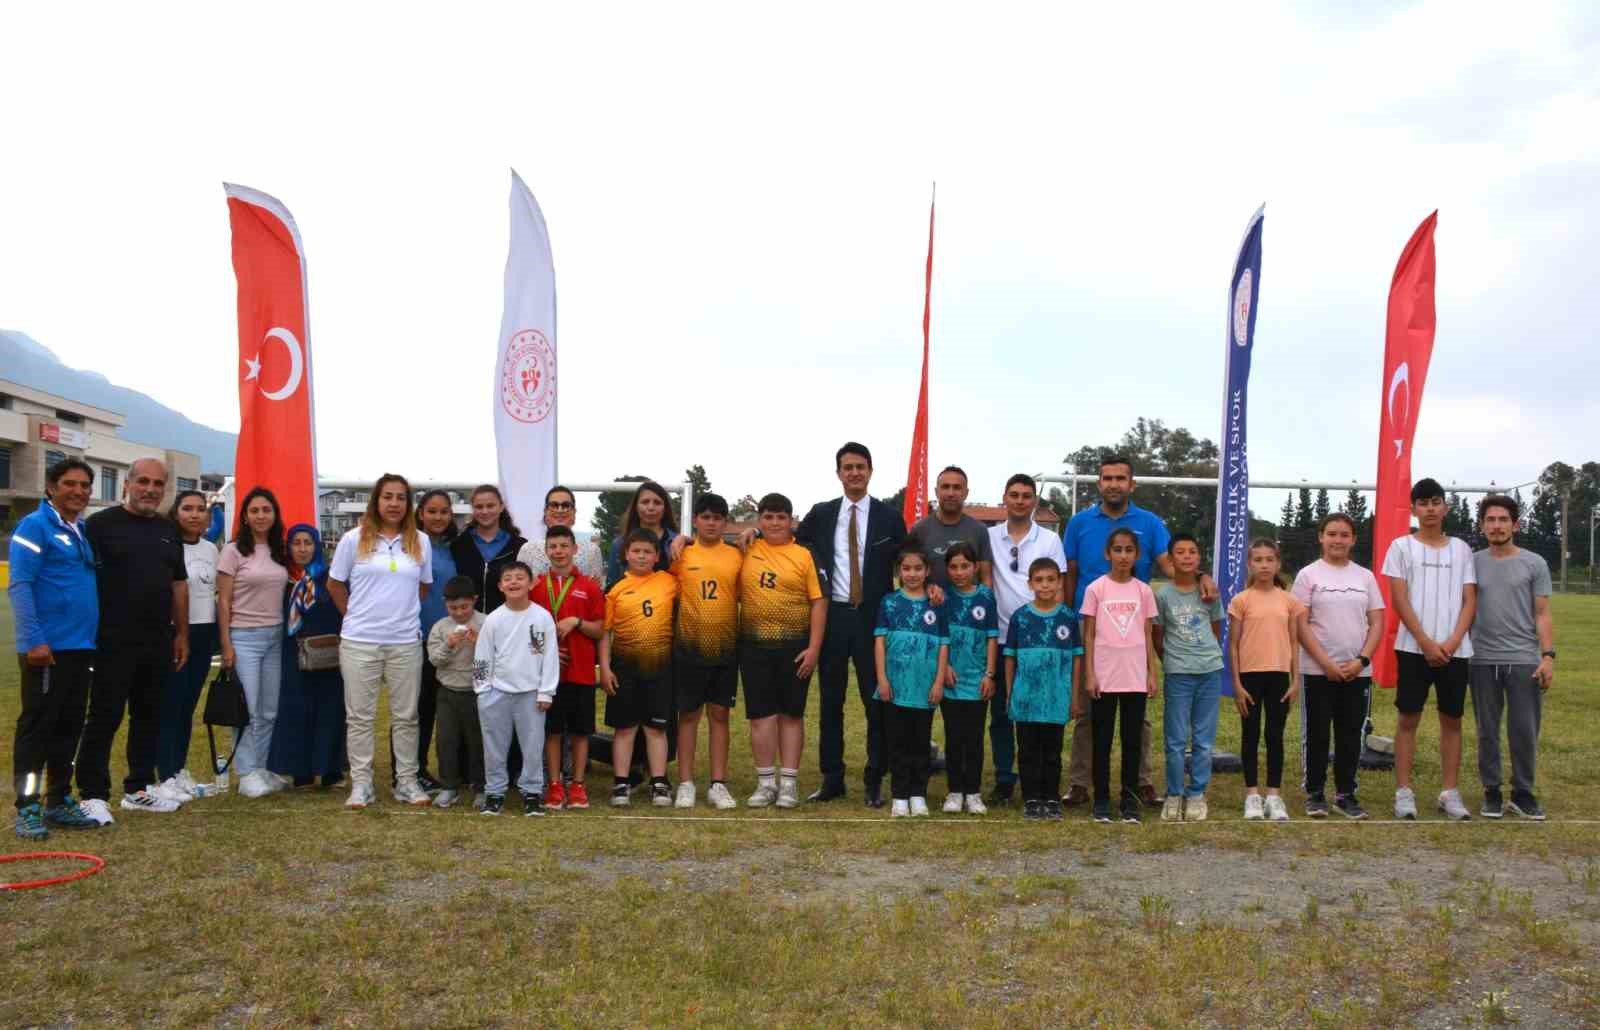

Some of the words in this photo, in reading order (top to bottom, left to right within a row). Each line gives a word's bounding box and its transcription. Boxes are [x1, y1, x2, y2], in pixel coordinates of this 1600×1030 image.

[1231, 390, 1241, 445] SPOR
[1229, 450, 1239, 477] VE
[1227, 482, 1239, 577] GENÇLİK
[701, 580, 718, 600] 12
[759, 571, 777, 589] 13
[642, 599, 653, 617] 6
[1106, 602, 1137, 612] GUESS
